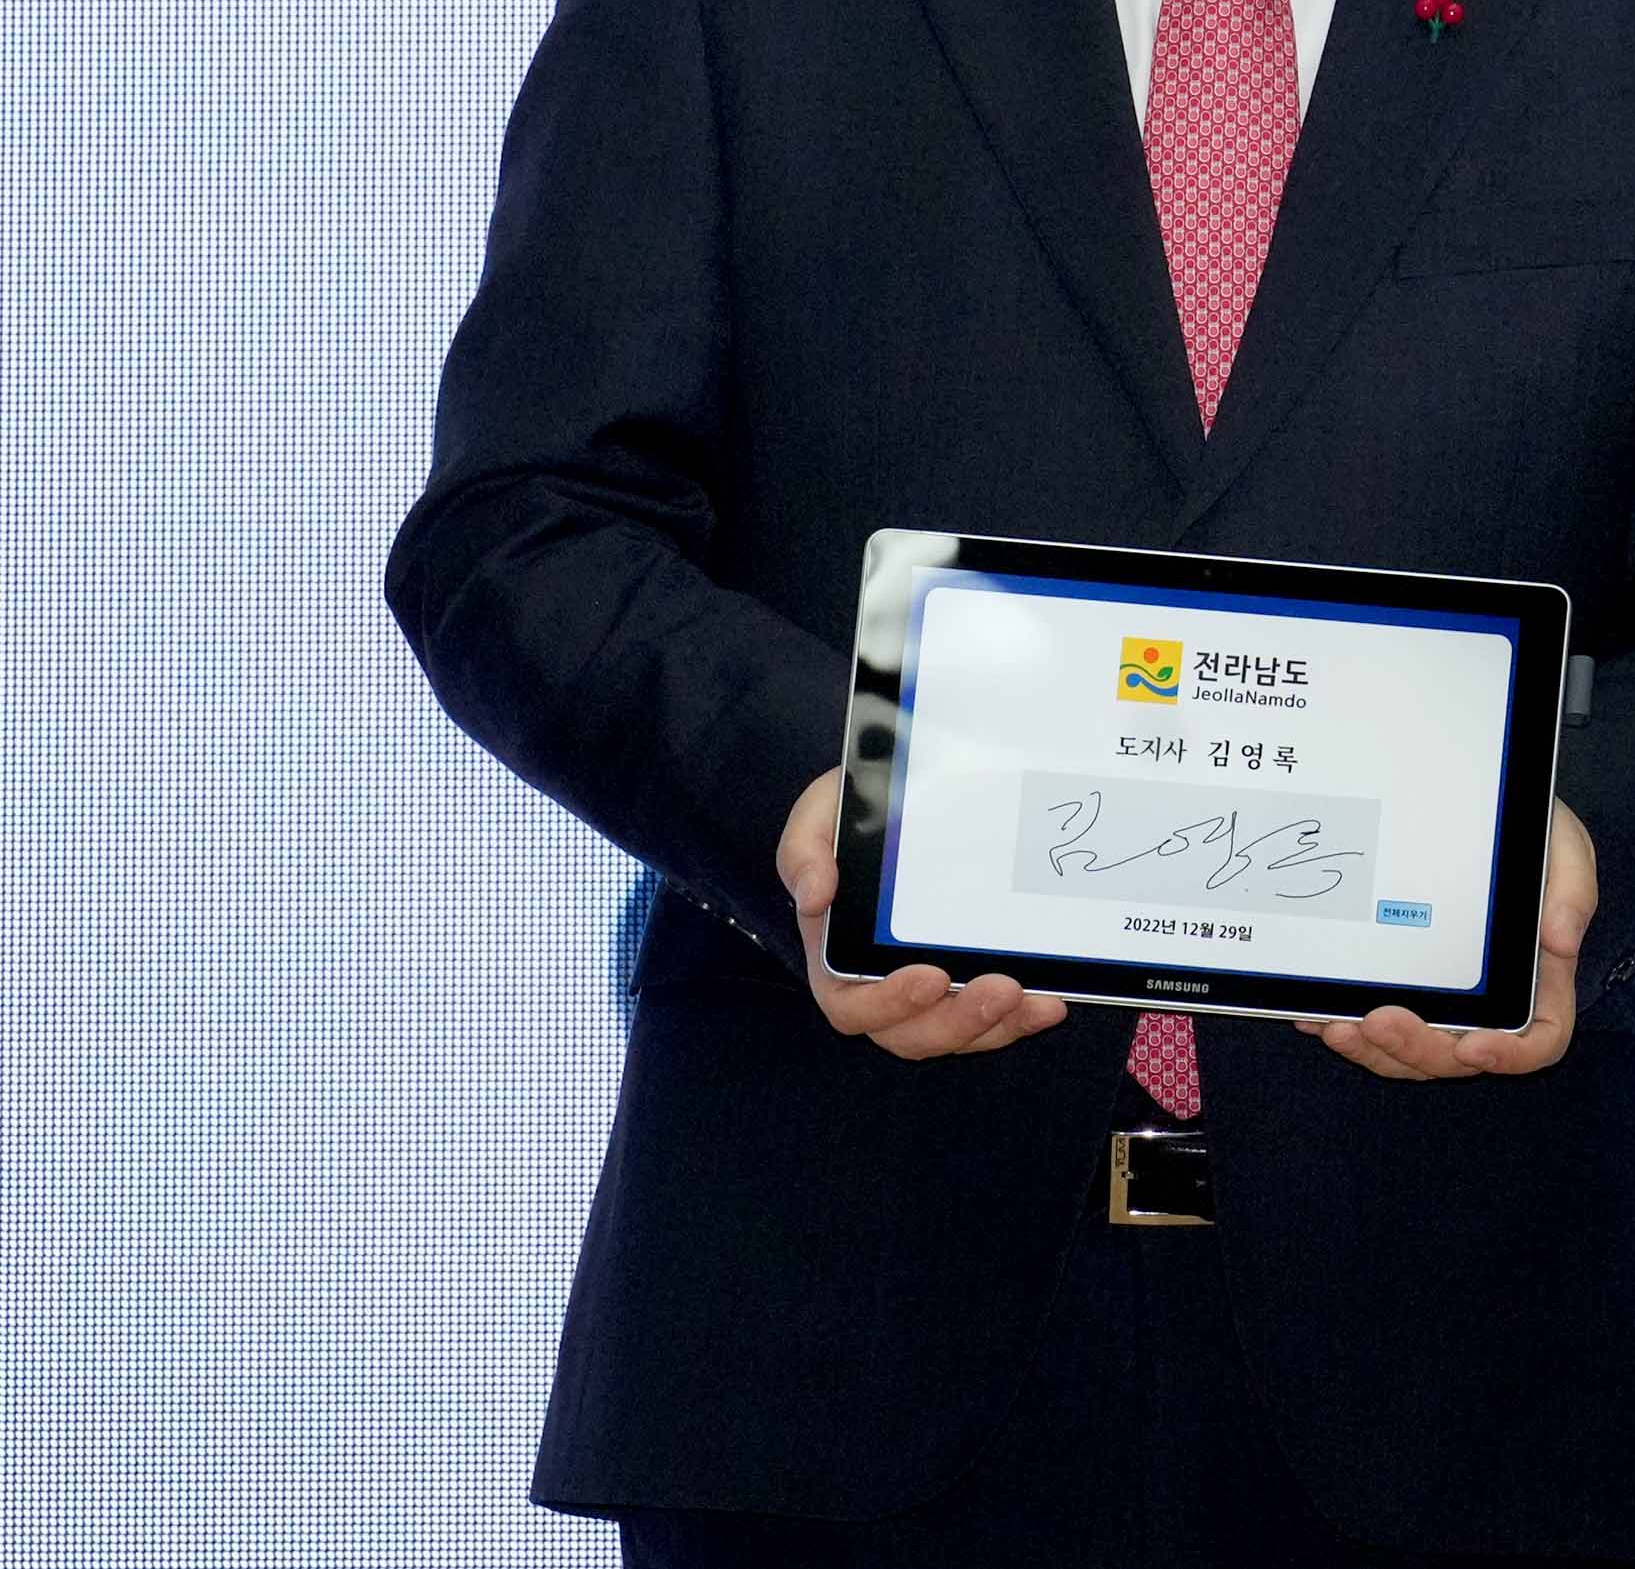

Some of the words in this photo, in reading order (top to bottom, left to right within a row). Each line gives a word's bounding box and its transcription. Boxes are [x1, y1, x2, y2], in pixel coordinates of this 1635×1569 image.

[1193, 651, 1310, 687] 전라남도
[1192, 687, 1307, 709] JeollaNamdo
[1115, 736, 1188, 764] 도지사
[1124, 917, 1177, 935] 2022년
[1182, 921, 1214, 939] 12월
[1218, 925, 1253, 942] 29일
[1146, 978, 1209, 994] SAMSUNG
